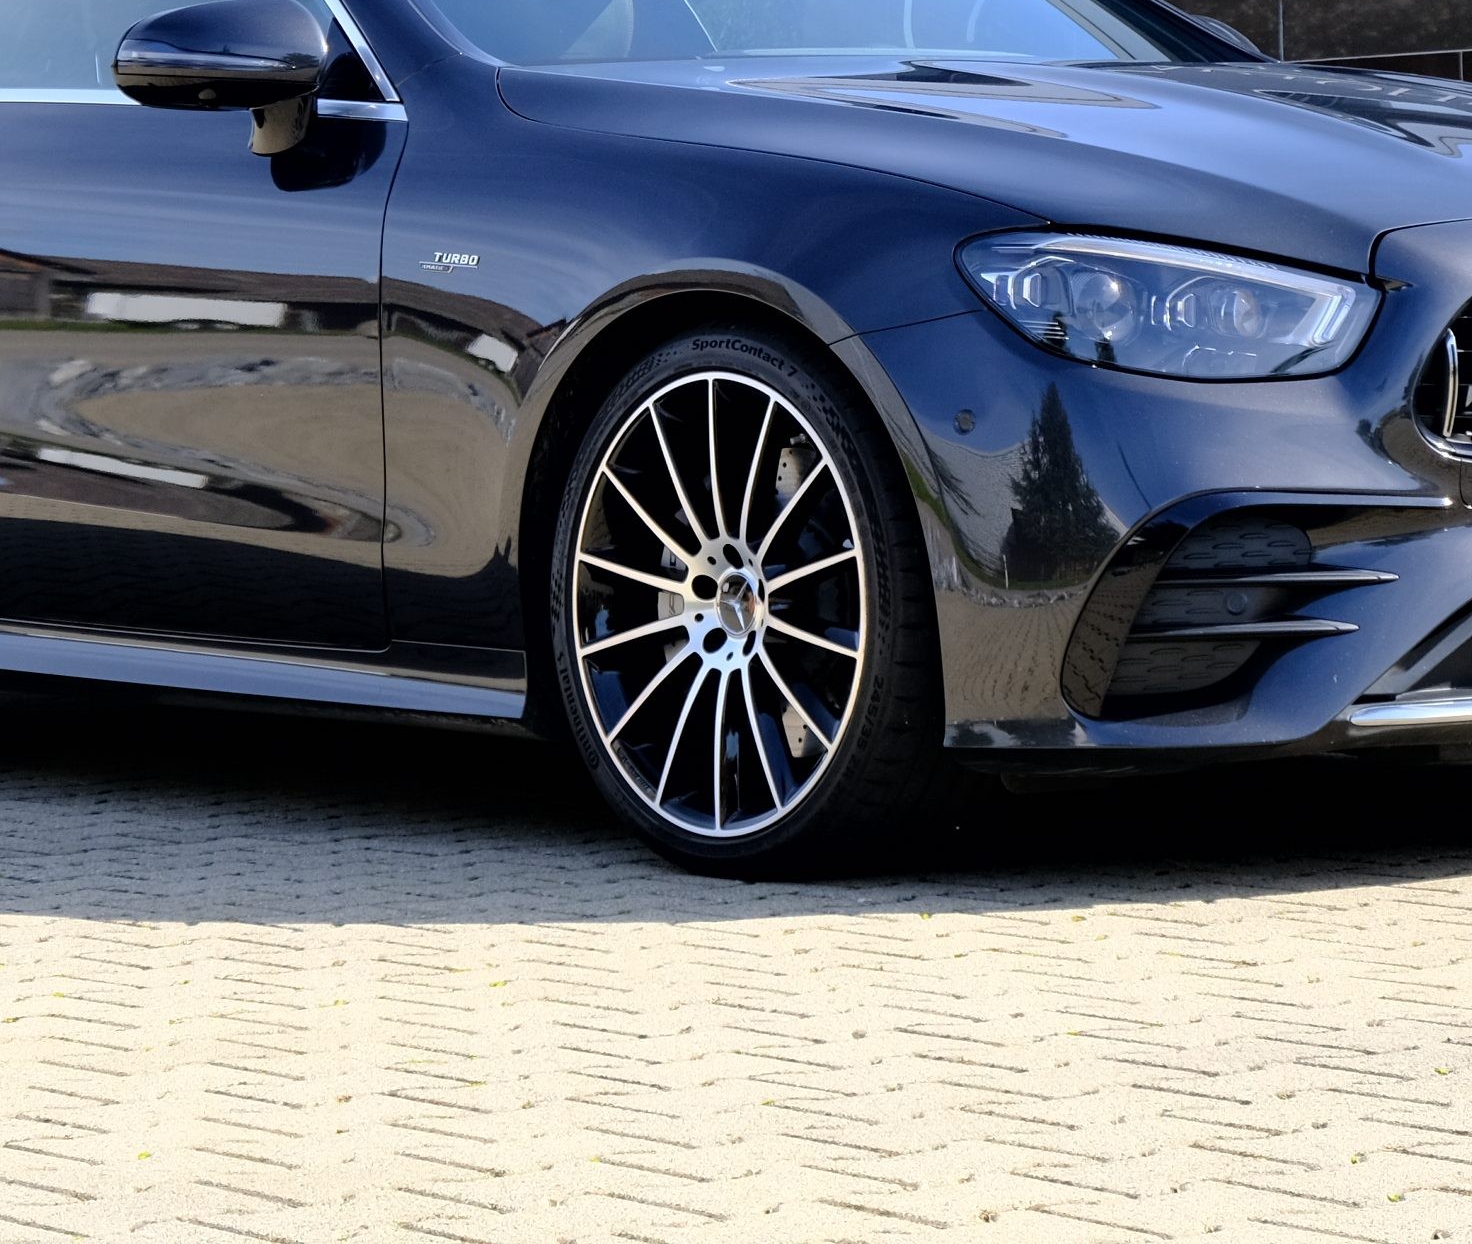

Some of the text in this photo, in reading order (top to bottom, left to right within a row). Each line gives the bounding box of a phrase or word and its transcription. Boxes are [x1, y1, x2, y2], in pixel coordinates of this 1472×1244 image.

[433, 252, 479, 265] TURBO
[691, 338, 799, 377] SportContact 7
